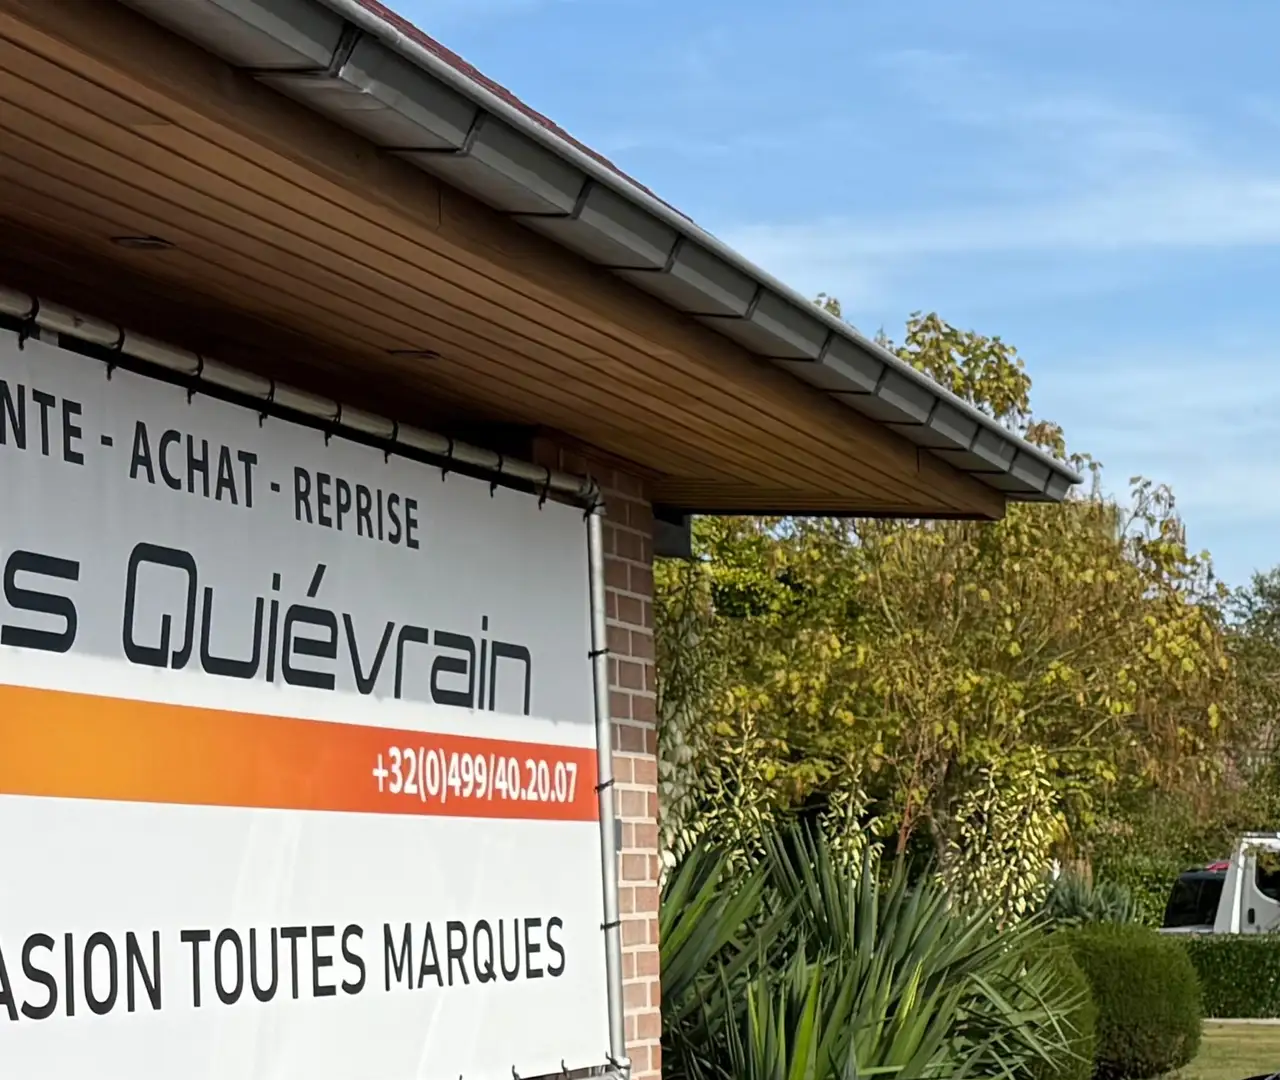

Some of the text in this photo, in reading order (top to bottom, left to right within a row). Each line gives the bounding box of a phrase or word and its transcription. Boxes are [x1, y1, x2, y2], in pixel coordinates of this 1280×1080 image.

[129, 420, 258, 508] ACHAT
[294, 466, 420, 549] REPRISE
[122, 542, 532, 716] Quiévrain
[372, 746, 578, 803] +32(0)499/40.20.07
[181, 924, 366, 1008] TOUTES
[384, 916, 566, 992] MARQUES
